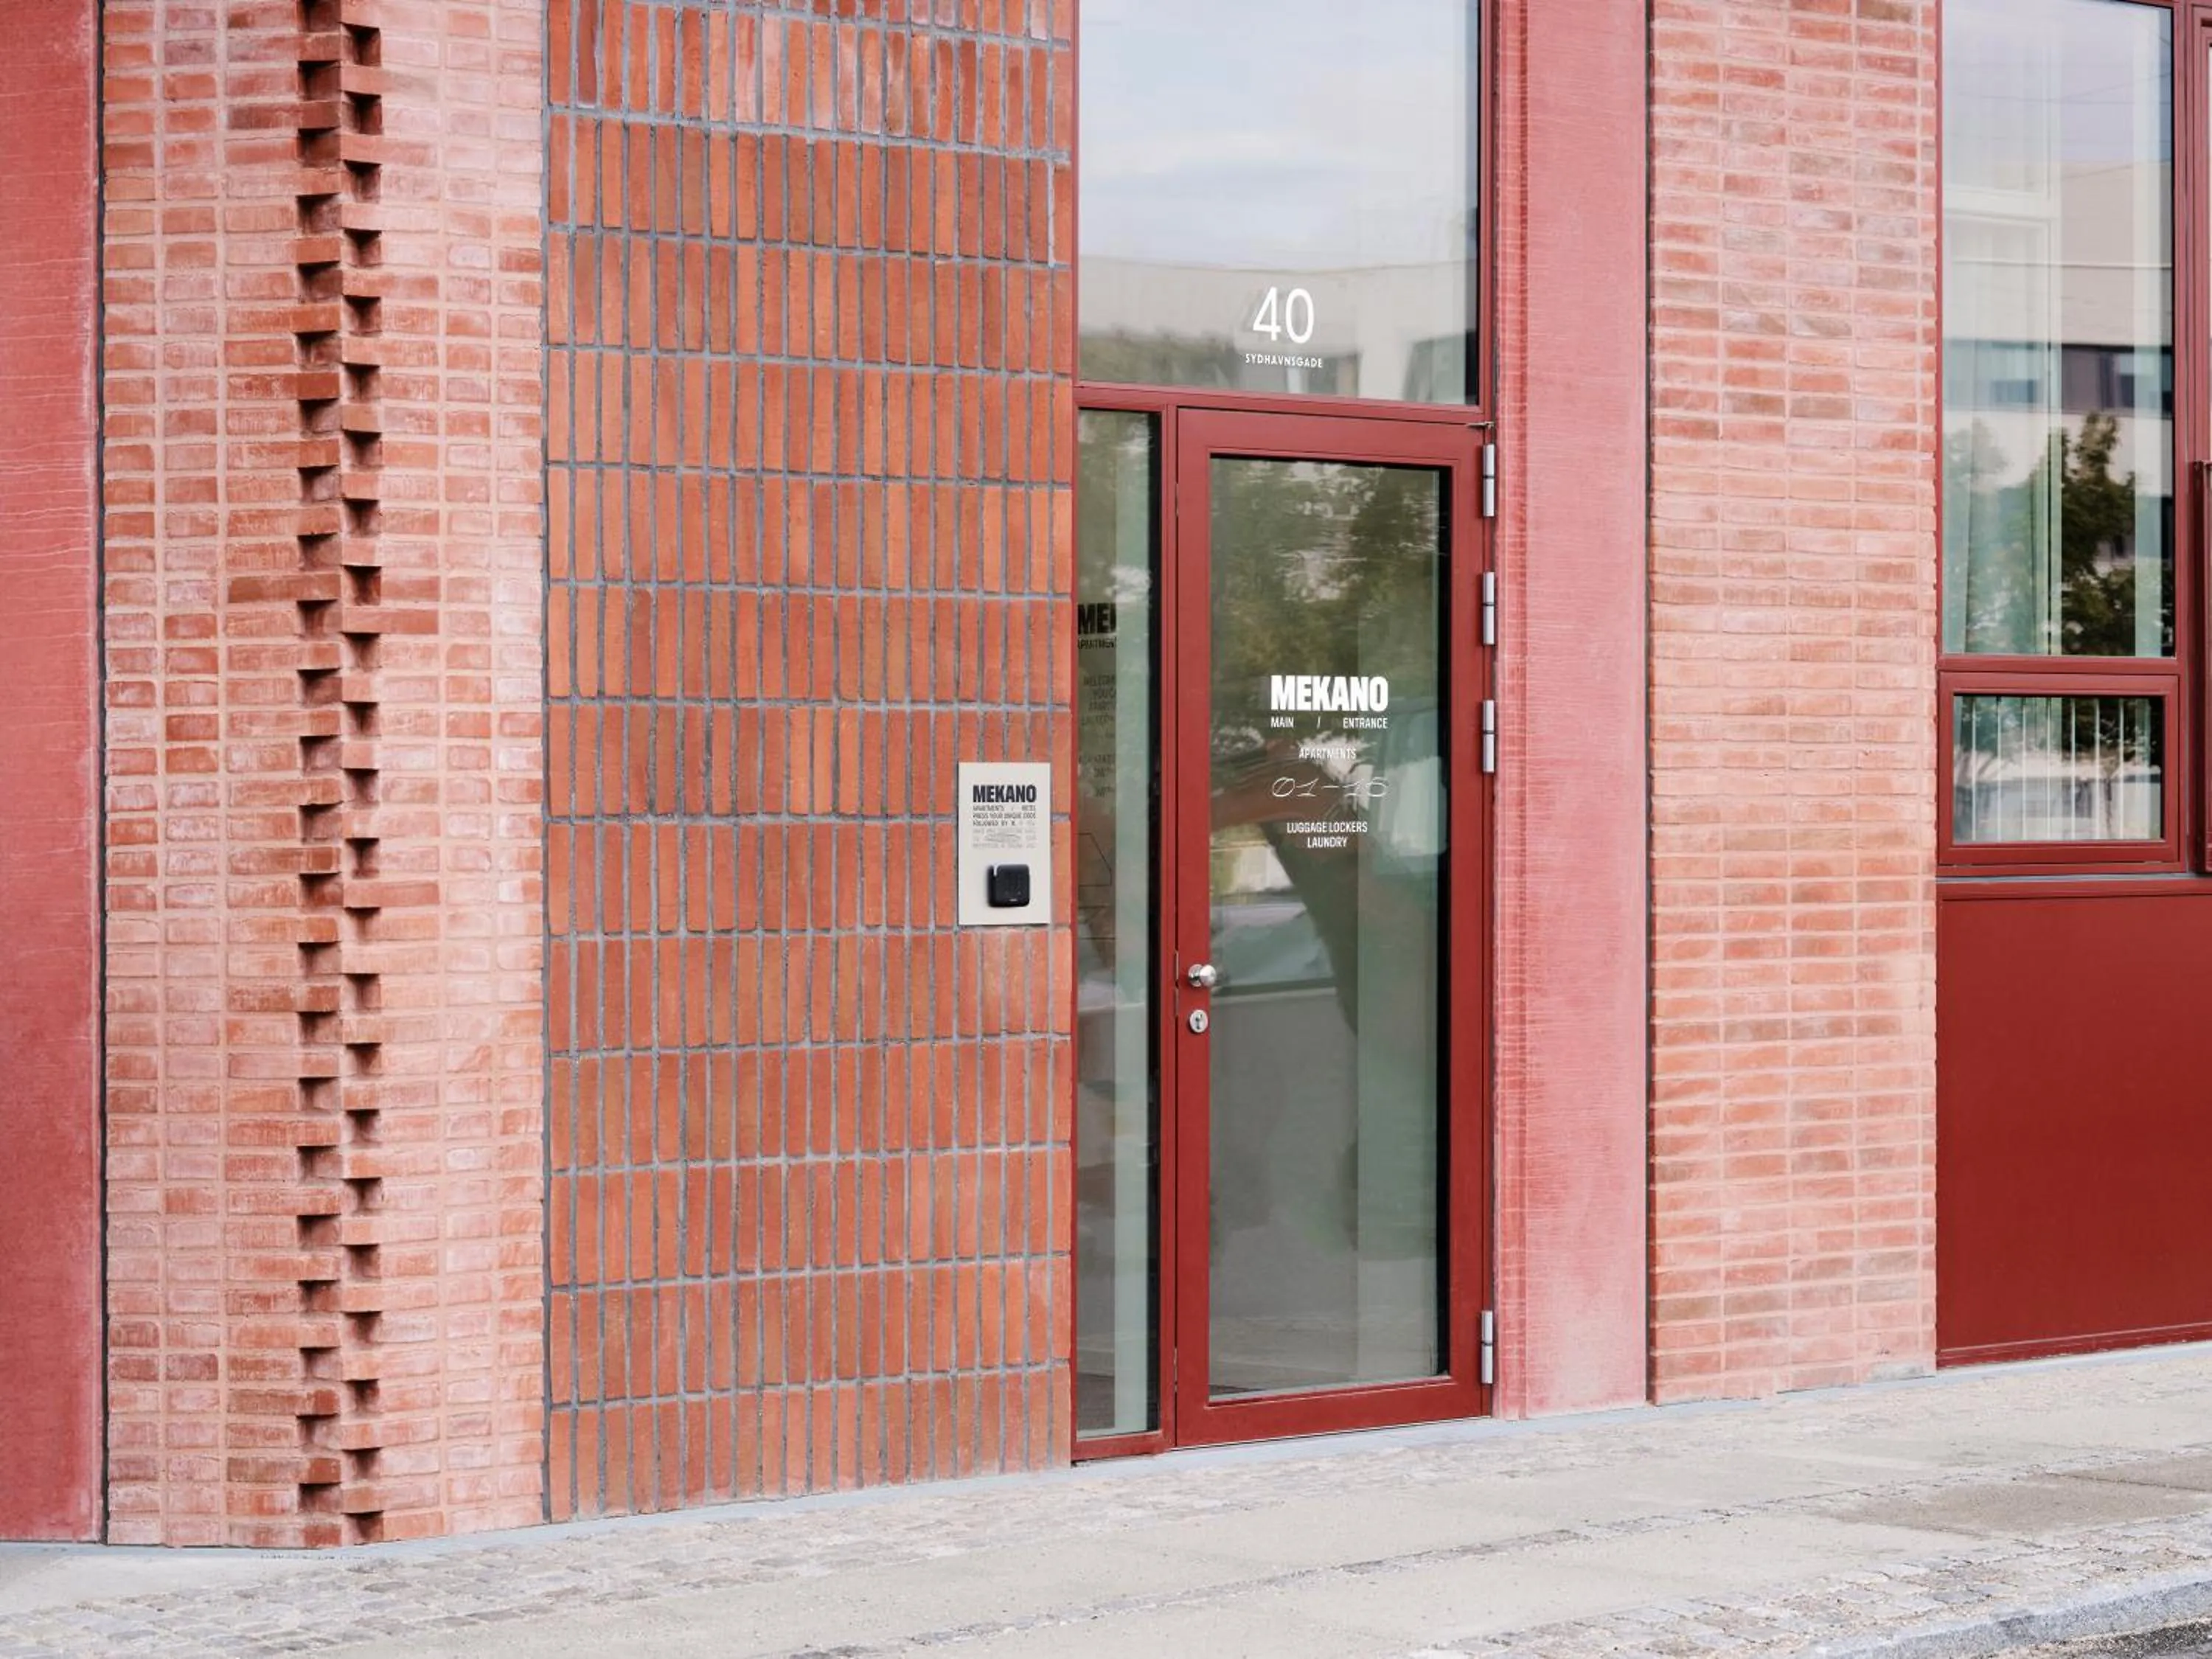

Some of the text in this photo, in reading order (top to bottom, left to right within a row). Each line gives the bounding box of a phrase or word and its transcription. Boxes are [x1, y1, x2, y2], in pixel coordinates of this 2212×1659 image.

[1253, 286, 1314, 344] 40
[1245, 353, 1323, 368] SYDHAVNSGADE
[1270, 675, 1388, 712] MEKANO
[1270, 716, 1294, 728] MAIN
[1343, 717, 1388, 729] ENTRANCE
[1298, 748, 1357, 759] APARTMENTS
[973, 784, 1037, 803] MEKANO
[1287, 821, 1368, 834] LUGGAGE LOCKERS
[1307, 836, 1348, 848] LAUNDRY
